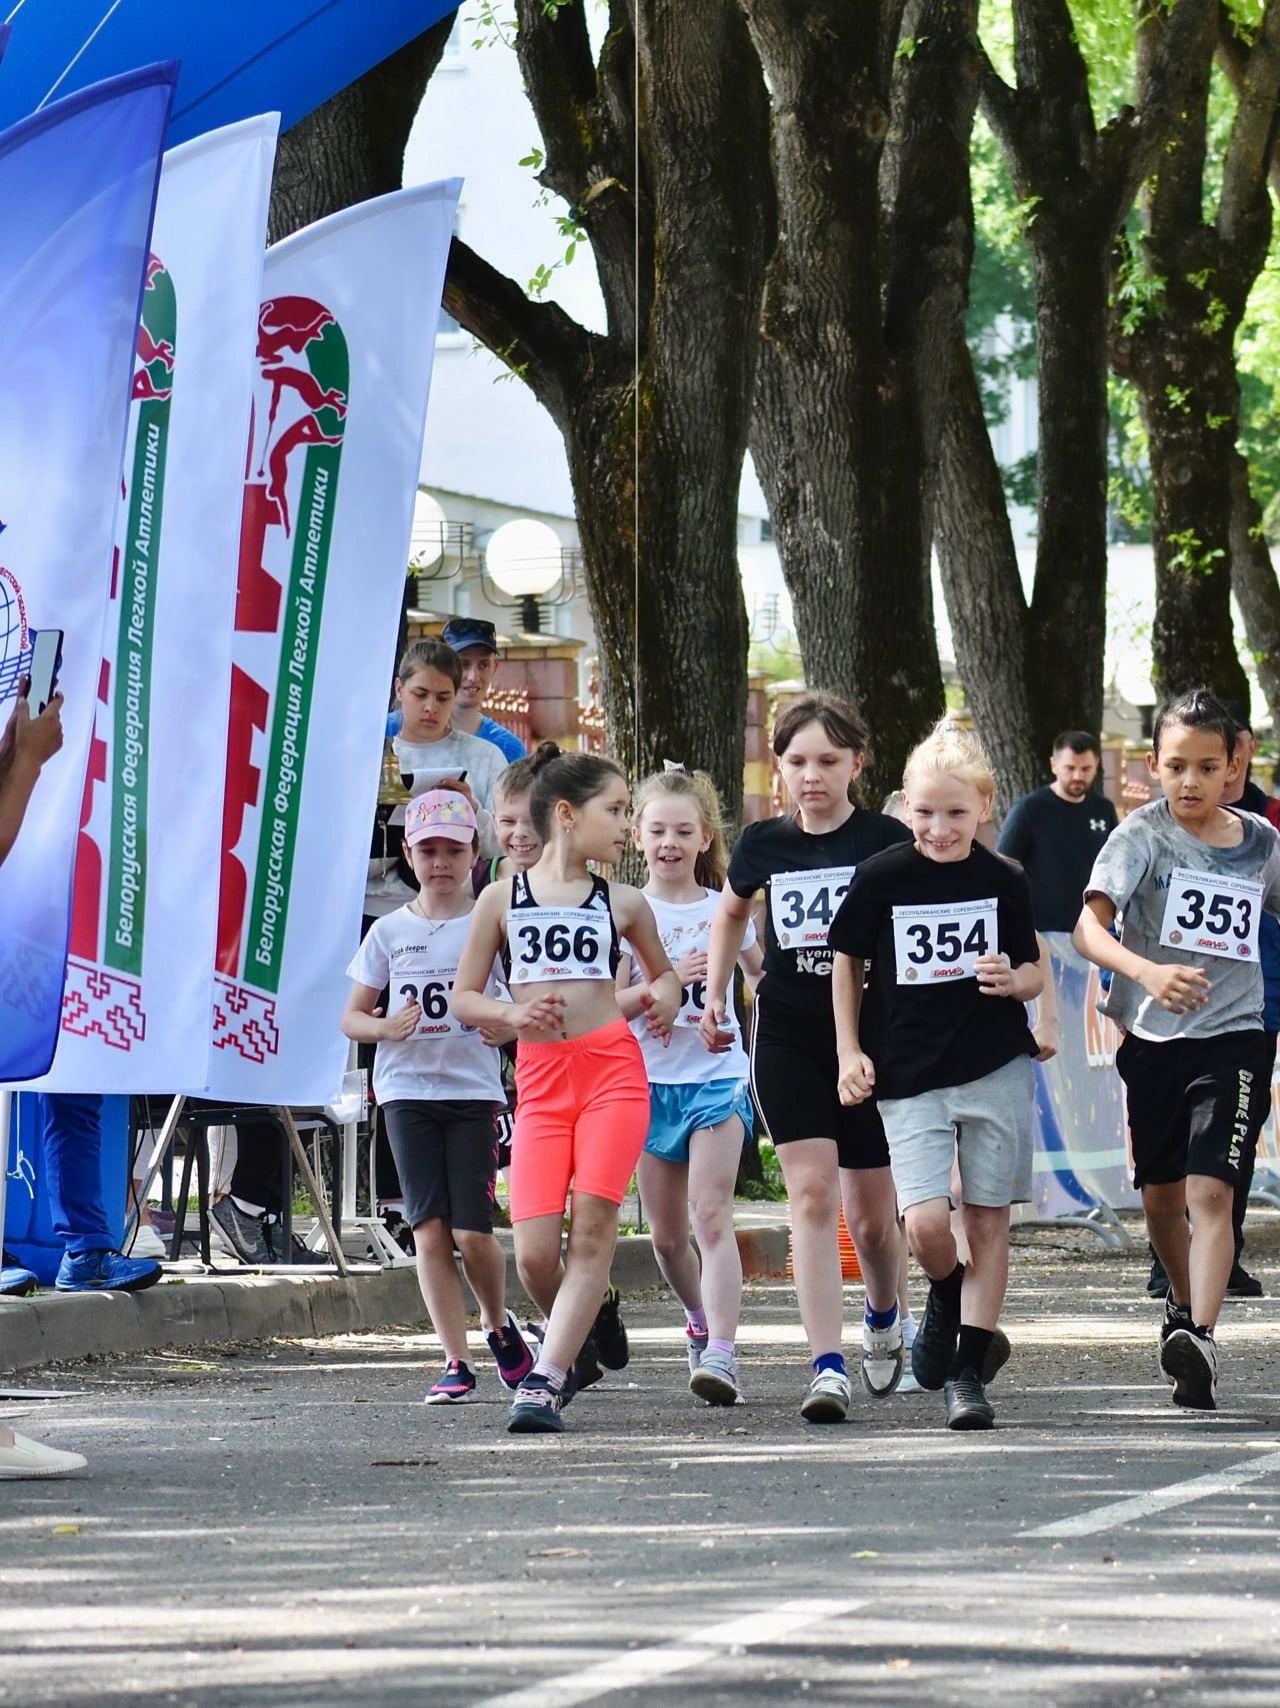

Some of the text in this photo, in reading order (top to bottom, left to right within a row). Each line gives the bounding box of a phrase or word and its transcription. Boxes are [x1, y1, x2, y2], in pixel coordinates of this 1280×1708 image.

[115, 422, 160, 948] Белорусская Федерация Легкой Атлетики
[256, 466, 329, 966] Белорусская Федерация Легкой Атлетики
[781, 885, 849, 928] 34
[1177, 889, 1252, 939] 353
[404, 945, 428, 953] deeper
[518, 924, 599, 964] 366
[907, 919, 989, 964] 354
[1228, 1069, 1254, 1170] GAME PLAY
